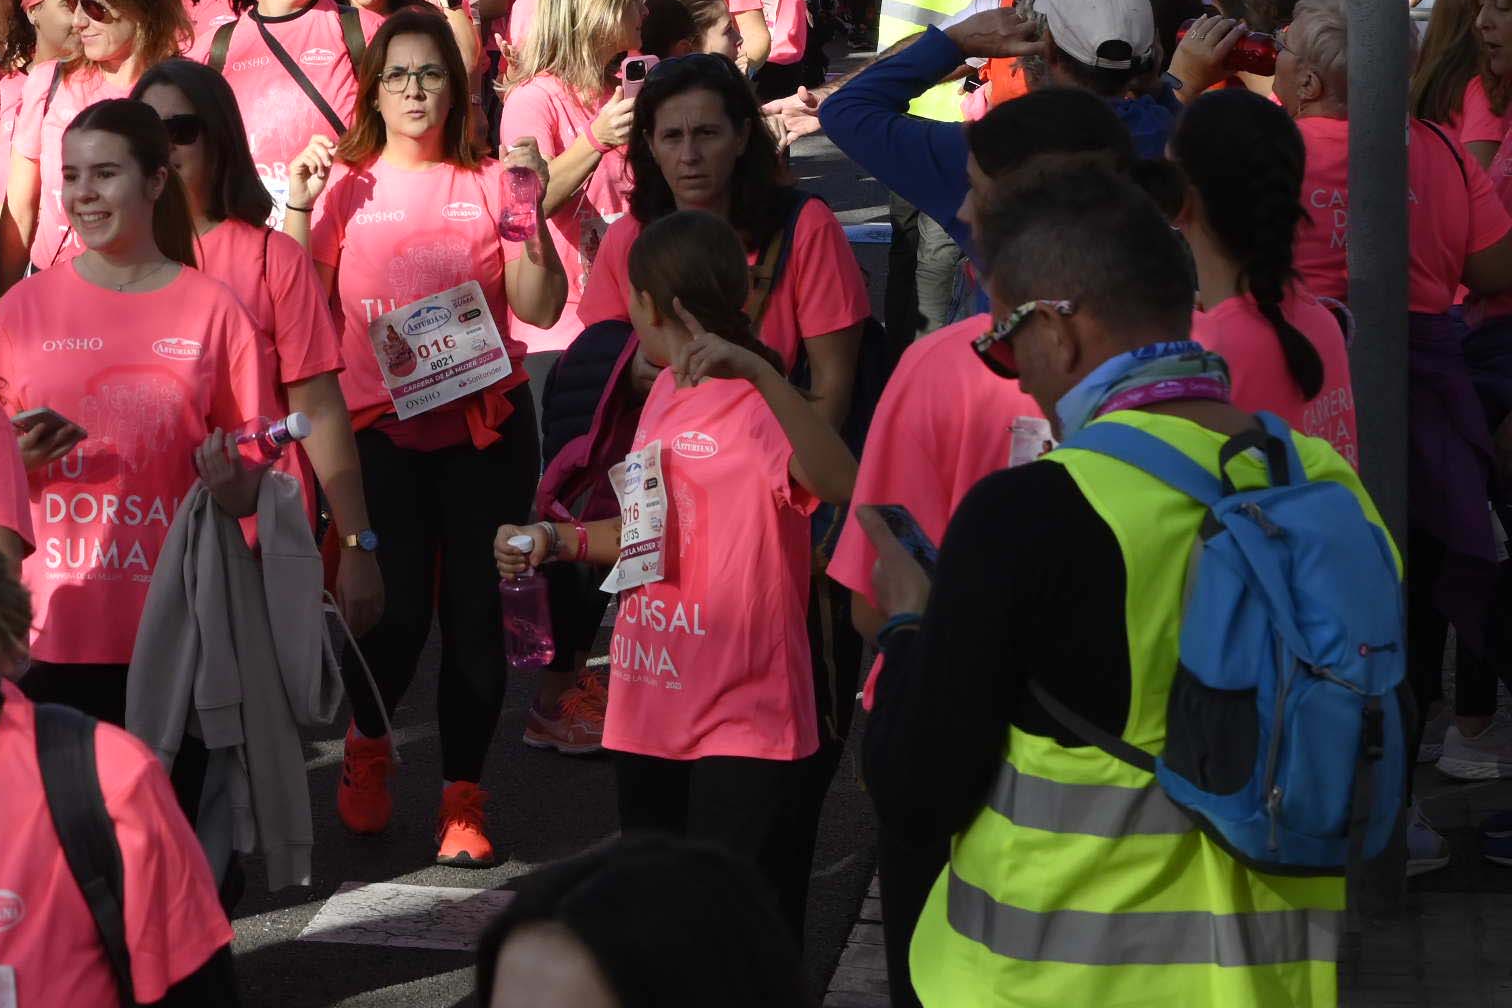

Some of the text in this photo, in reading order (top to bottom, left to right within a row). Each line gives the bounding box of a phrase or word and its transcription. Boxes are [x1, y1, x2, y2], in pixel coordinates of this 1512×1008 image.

[356, 209, 407, 225] OYSHO
[42, 337, 104, 353] OYSHO
[417, 334, 457, 360] 016
[430, 354, 456, 372] 8021
[45, 538, 150, 571] SUMA
[612, 635, 679, 678] SUMA
